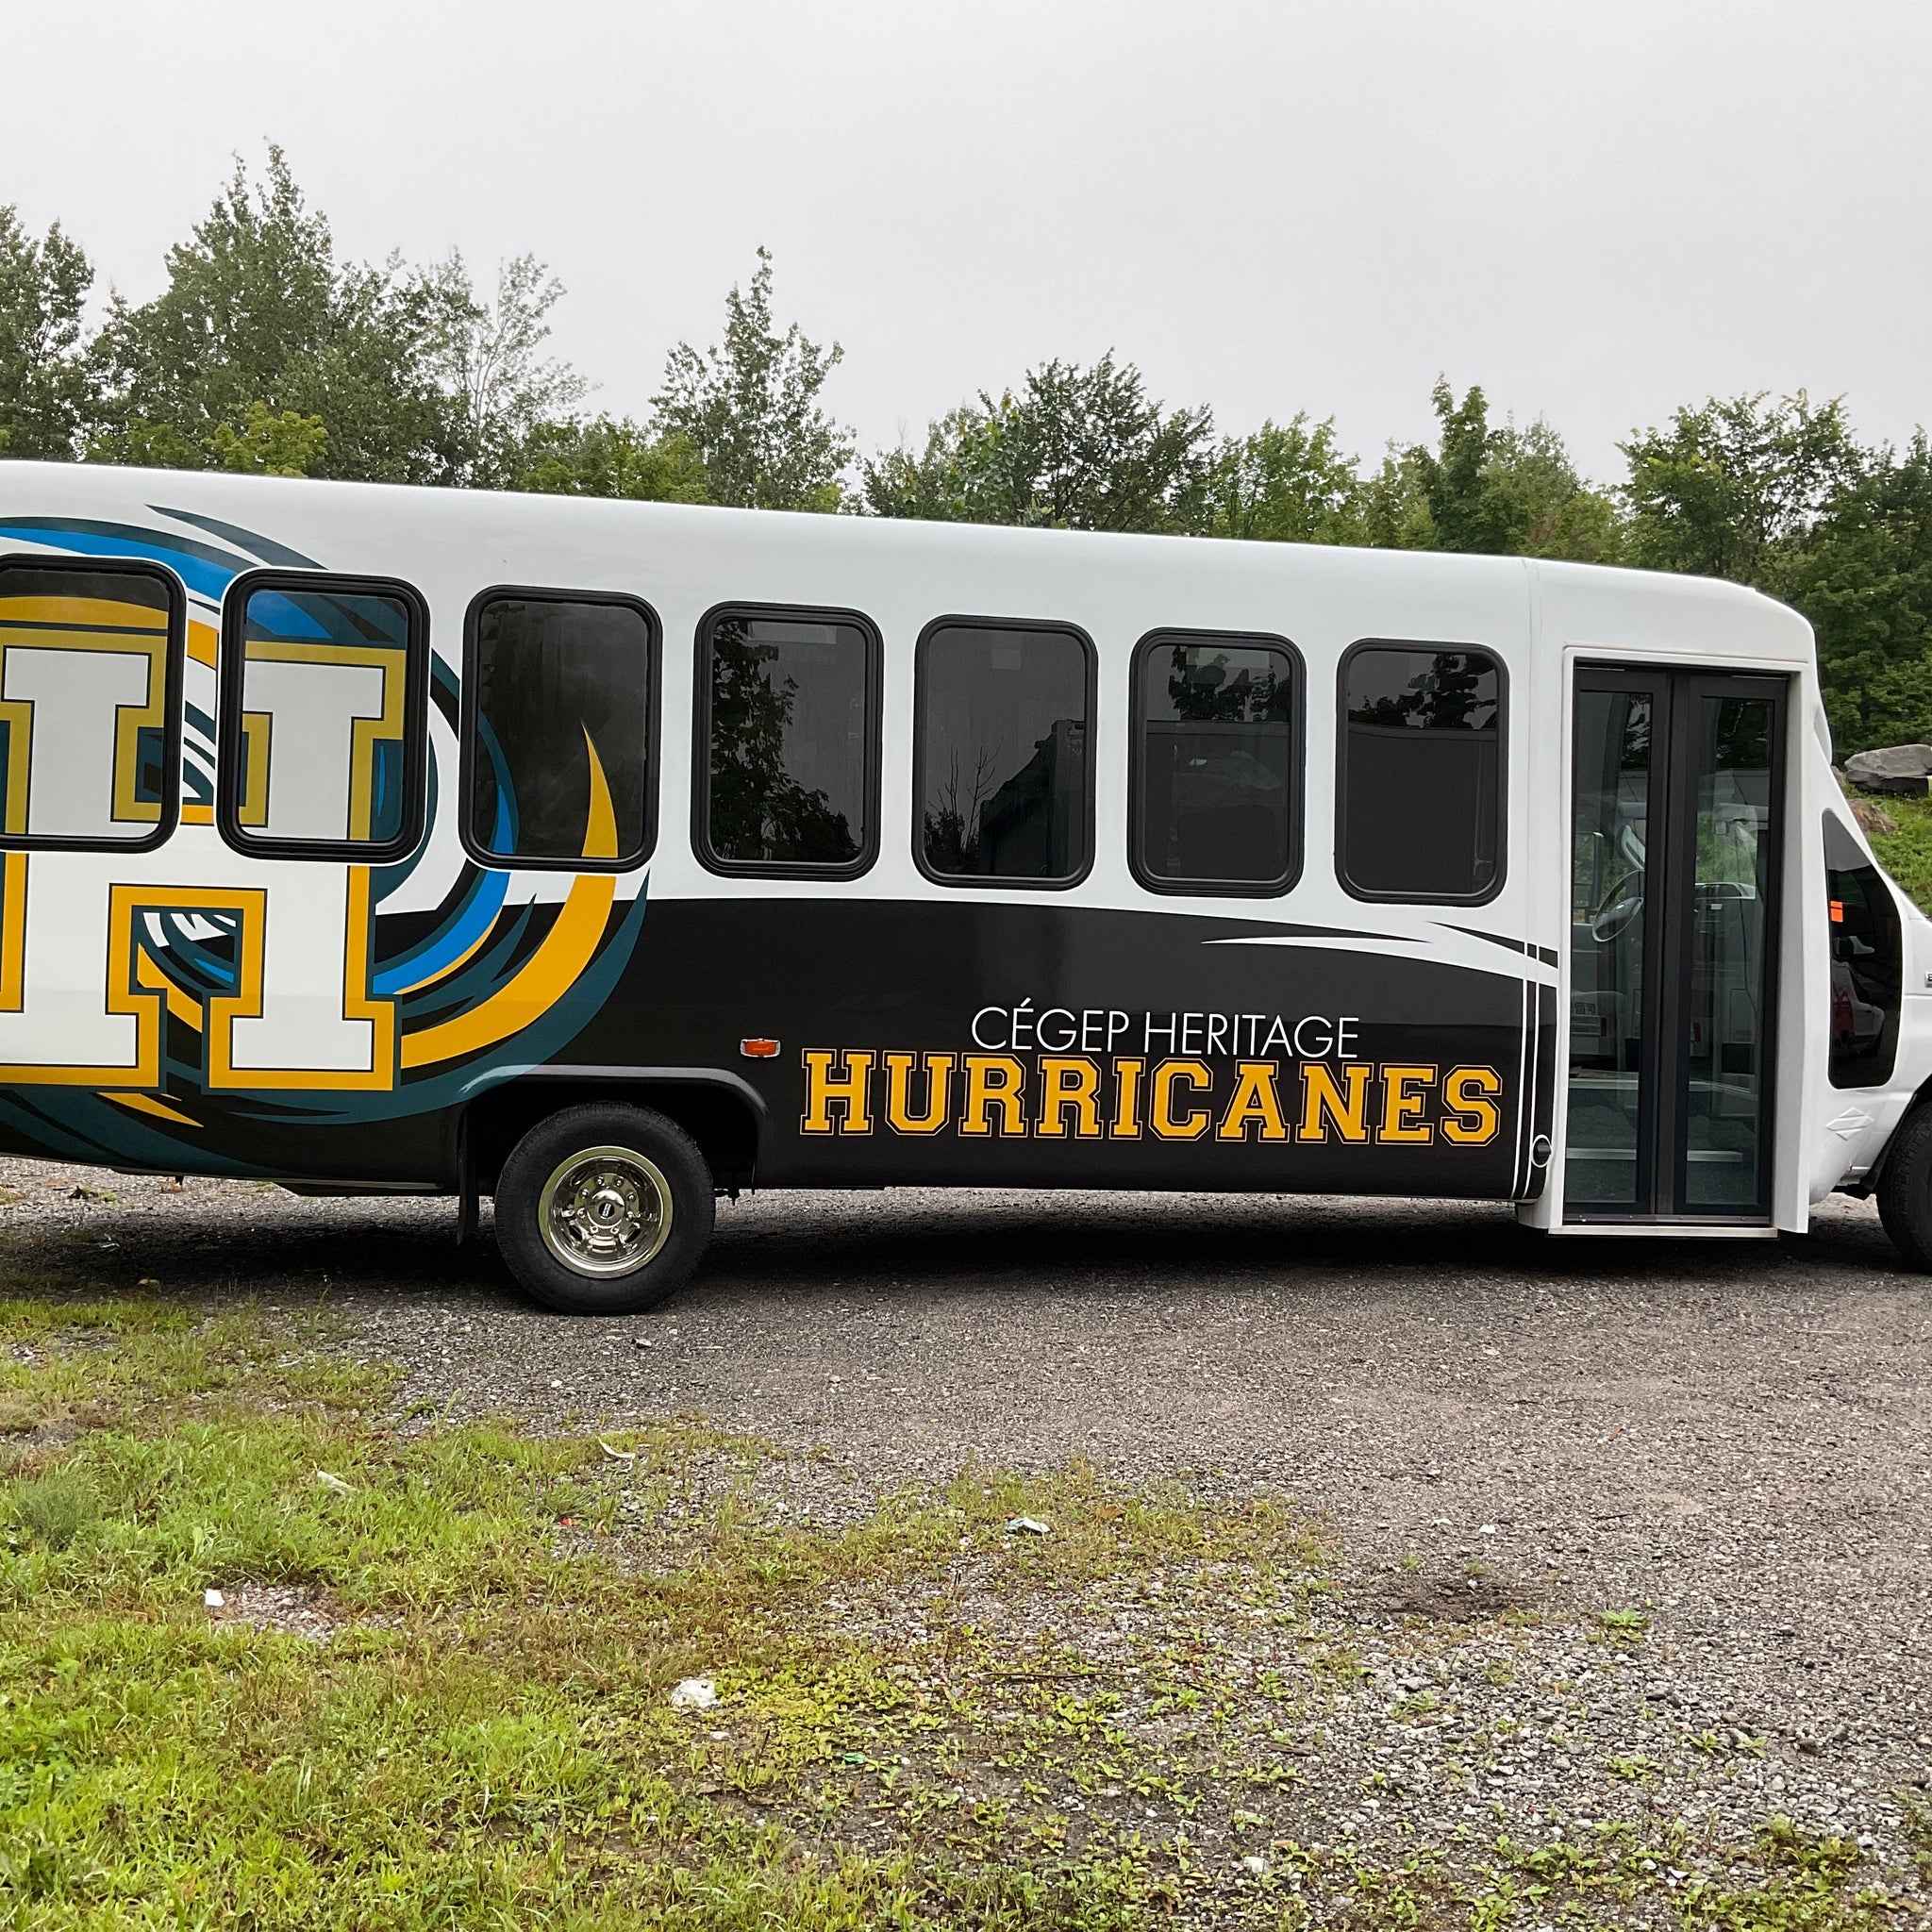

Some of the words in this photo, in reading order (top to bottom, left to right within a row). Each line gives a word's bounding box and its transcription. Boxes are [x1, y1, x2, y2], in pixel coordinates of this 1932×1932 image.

[971, 997, 1129, 1052] CÉGEP
[1144, 1011, 1359, 1058] HERITAGE
[799, 1048, 1503, 1146] HURRICANES
